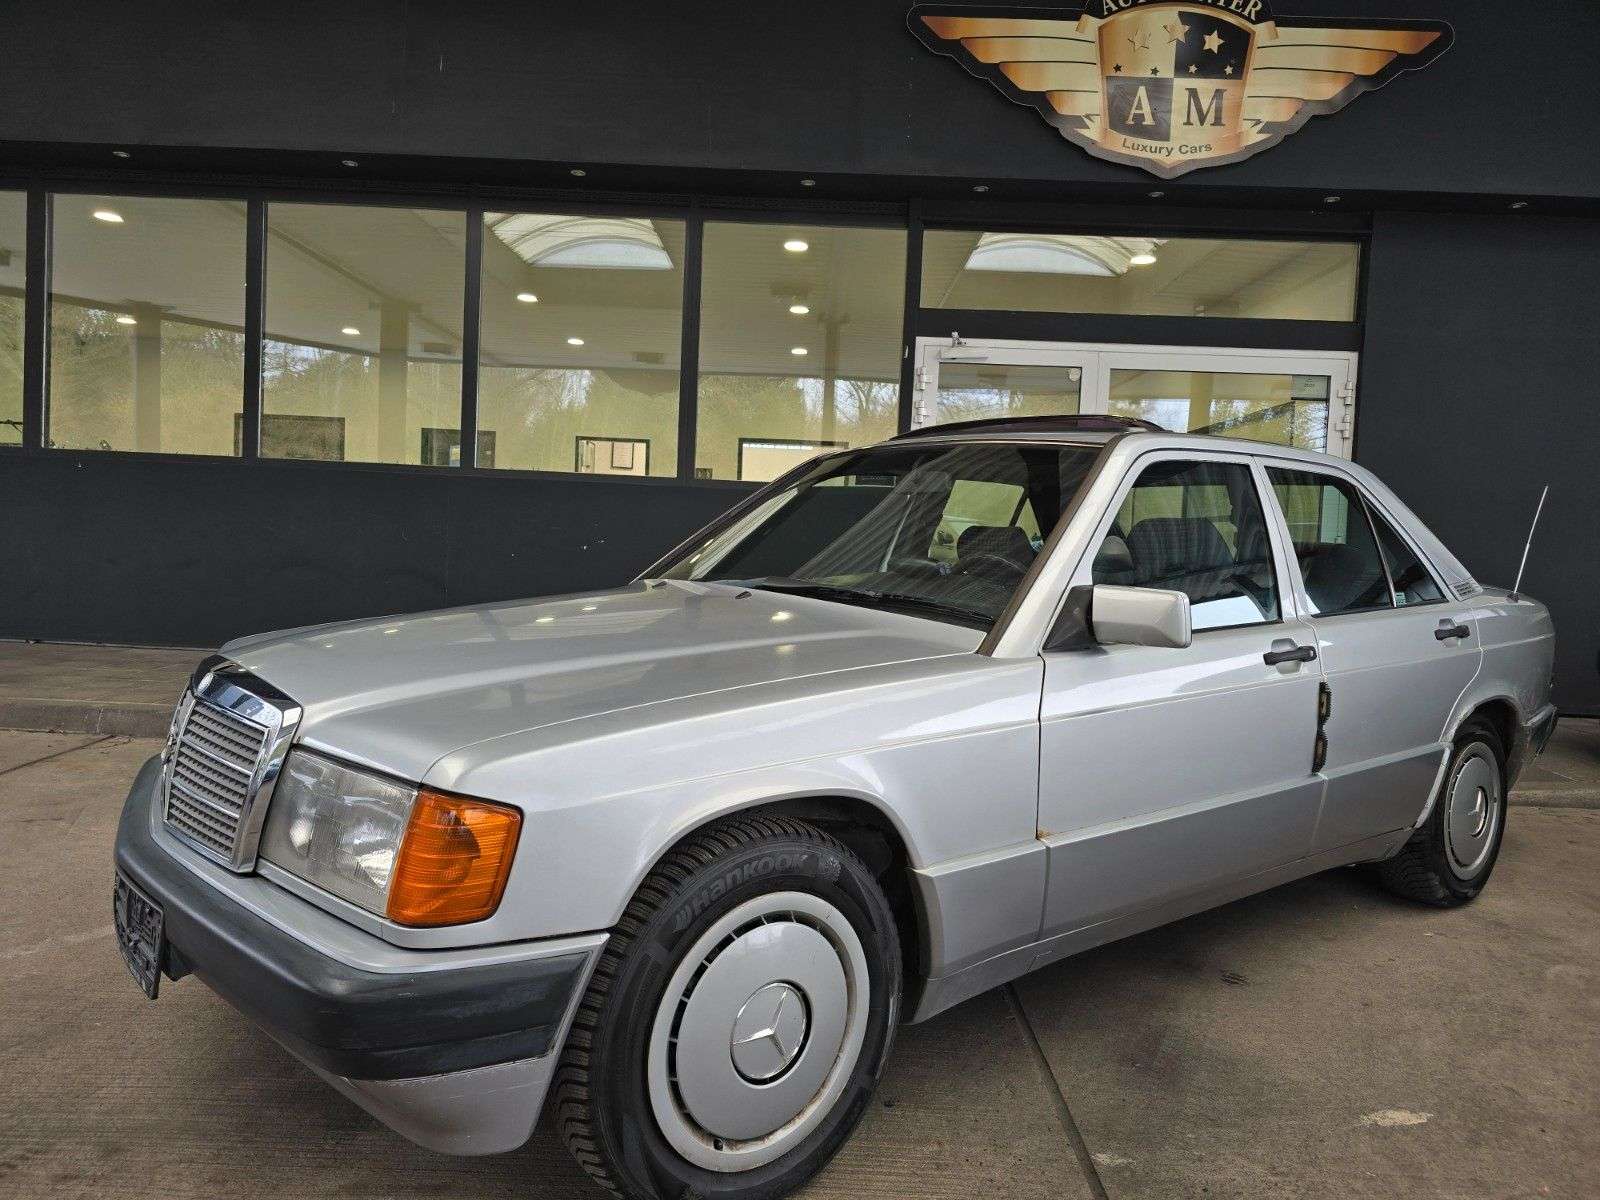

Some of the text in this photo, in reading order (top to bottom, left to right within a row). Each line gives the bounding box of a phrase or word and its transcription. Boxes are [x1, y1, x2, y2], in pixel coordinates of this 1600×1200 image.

[1126, 86, 1227, 127] A M
[1122, 138, 1213, 157] Luxury Cars
